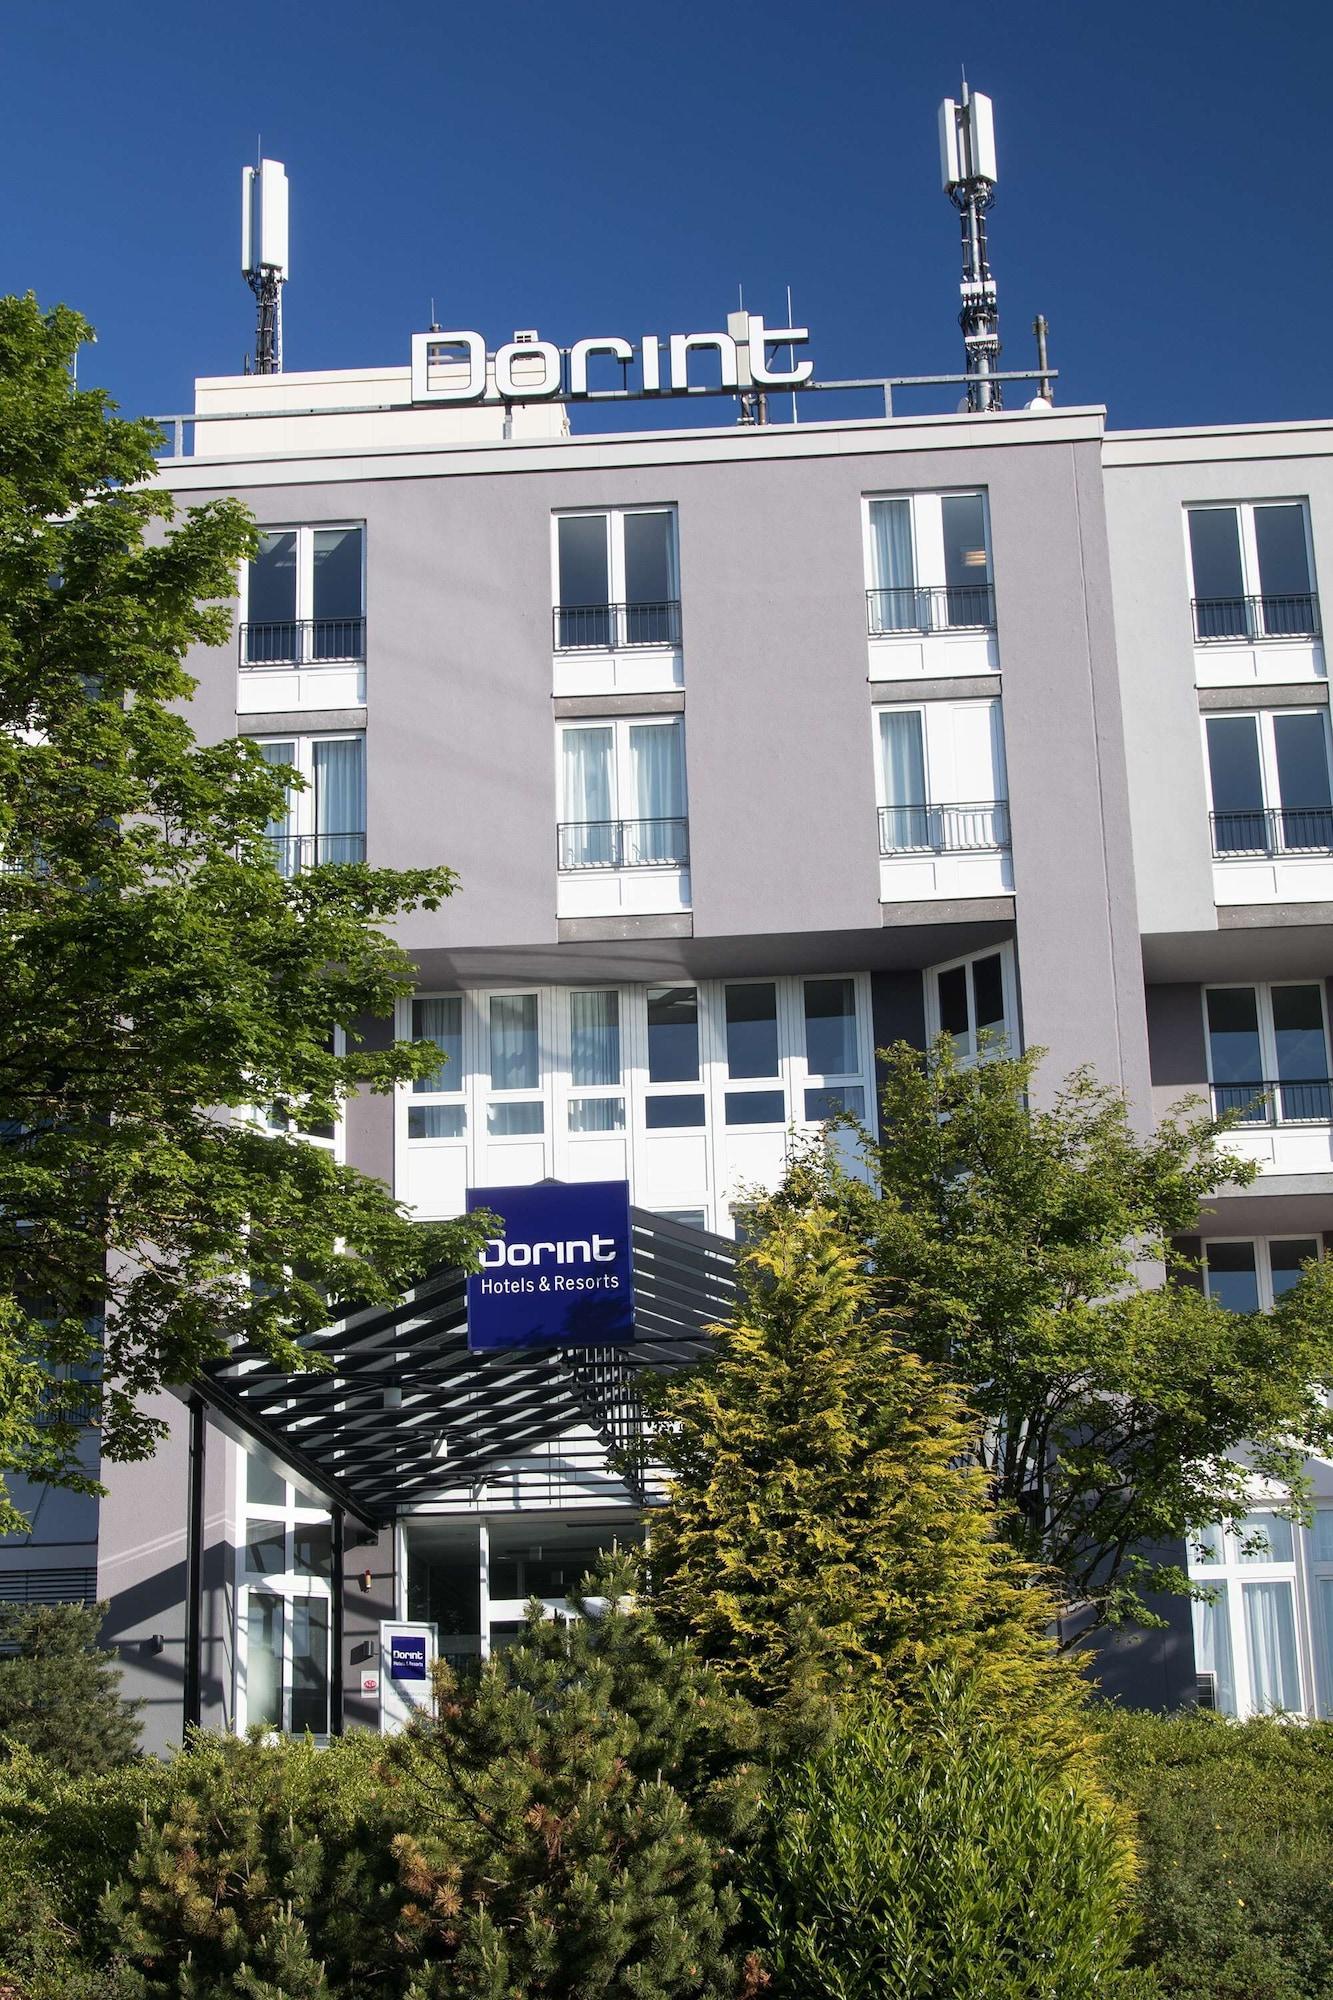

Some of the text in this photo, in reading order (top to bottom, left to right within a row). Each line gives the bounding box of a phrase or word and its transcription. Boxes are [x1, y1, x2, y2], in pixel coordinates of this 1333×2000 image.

[411, 315, 814, 401] Dorint
[478, 1234, 617, 1268] Dorint
[481, 1274, 619, 1295] Hotels & Resorts
[393, 1650, 424, 1660] Dorint
